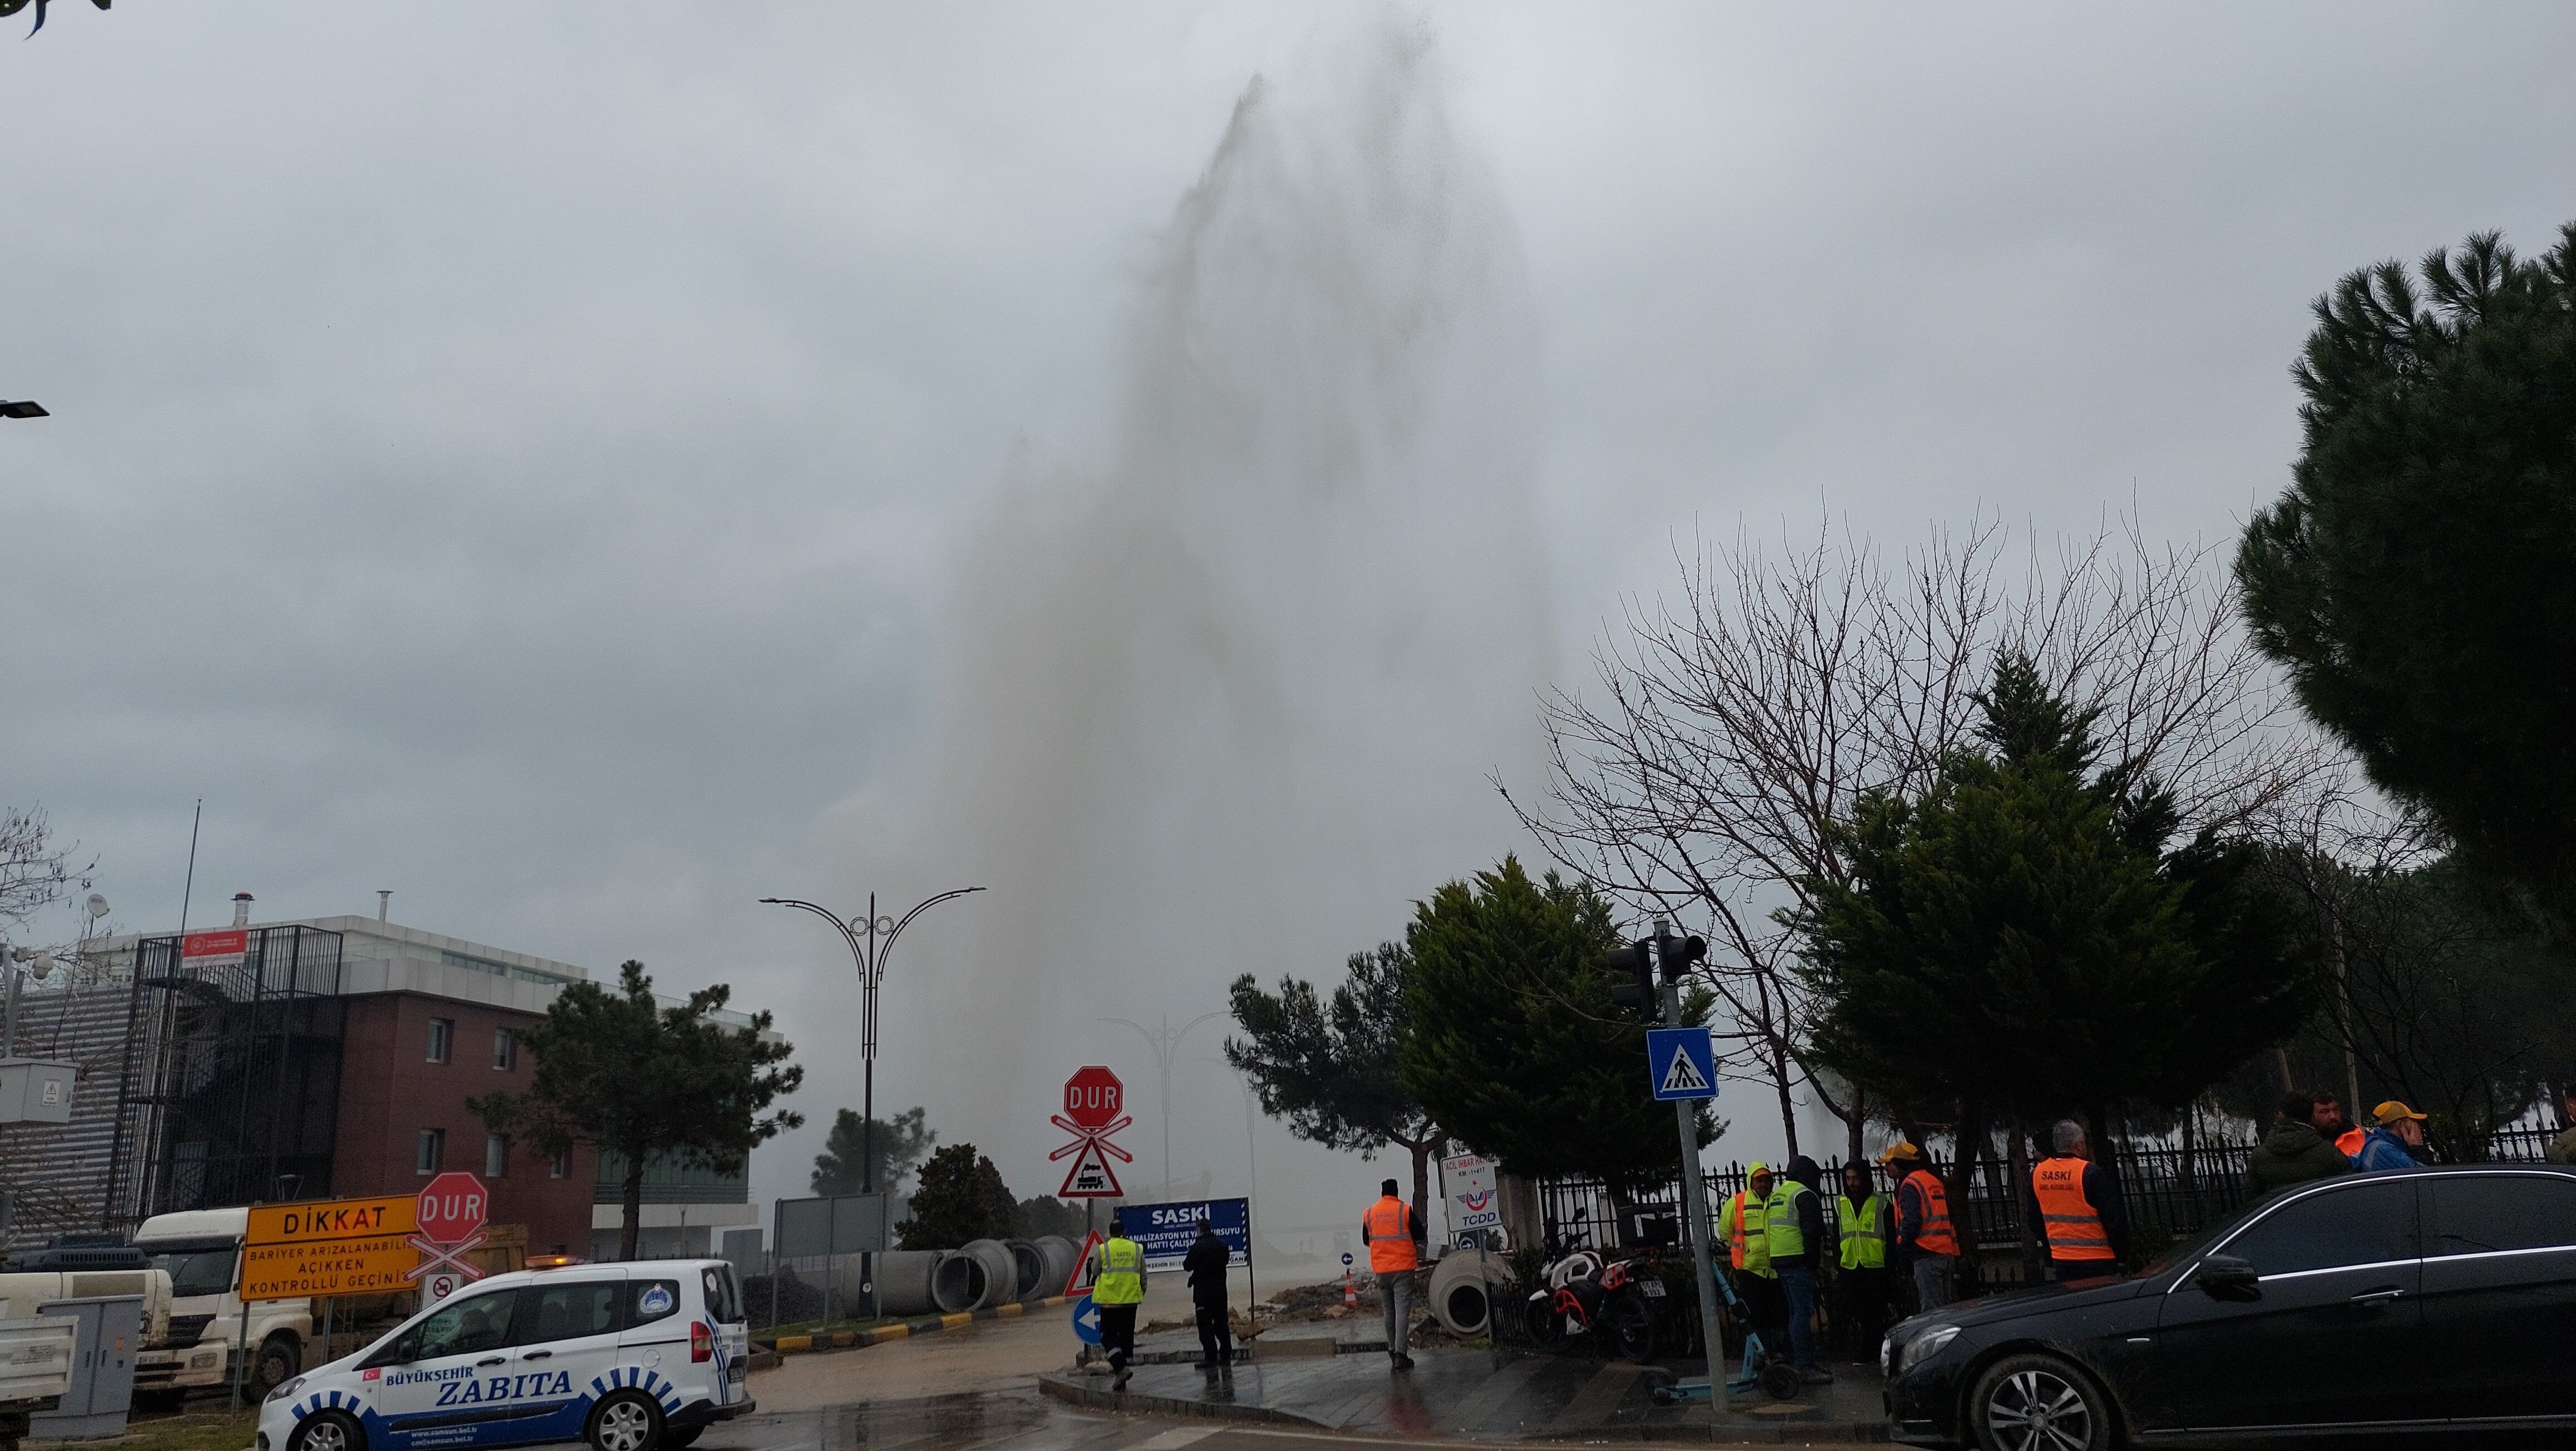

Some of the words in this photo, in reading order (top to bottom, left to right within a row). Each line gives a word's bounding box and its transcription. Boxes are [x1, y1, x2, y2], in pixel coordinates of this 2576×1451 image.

[1070, 1086, 1116, 1109] DUR
[2042, 1169, 2072, 1181] SASKİ
[422, 1194, 480, 1221] DUR
[1152, 1204, 1211, 1225] SASKİ
[284, 1206, 386, 1234] DİKKAT
[1462, 1212, 1496, 1226] TCDD
[1126, 1232, 1179, 1242] ANALİZASYON
[1147, 1241, 1168, 1250] HATTI
[250, 1248, 304, 1260] BARİYER
[311, 1240, 414, 1255] ARIZALANABİLİ
[298, 1258, 364, 1274] AÇIKKEN
[250, 1274, 338, 1294] KONTROLLÜ
[436, 1370, 573, 1406] ZABITA
